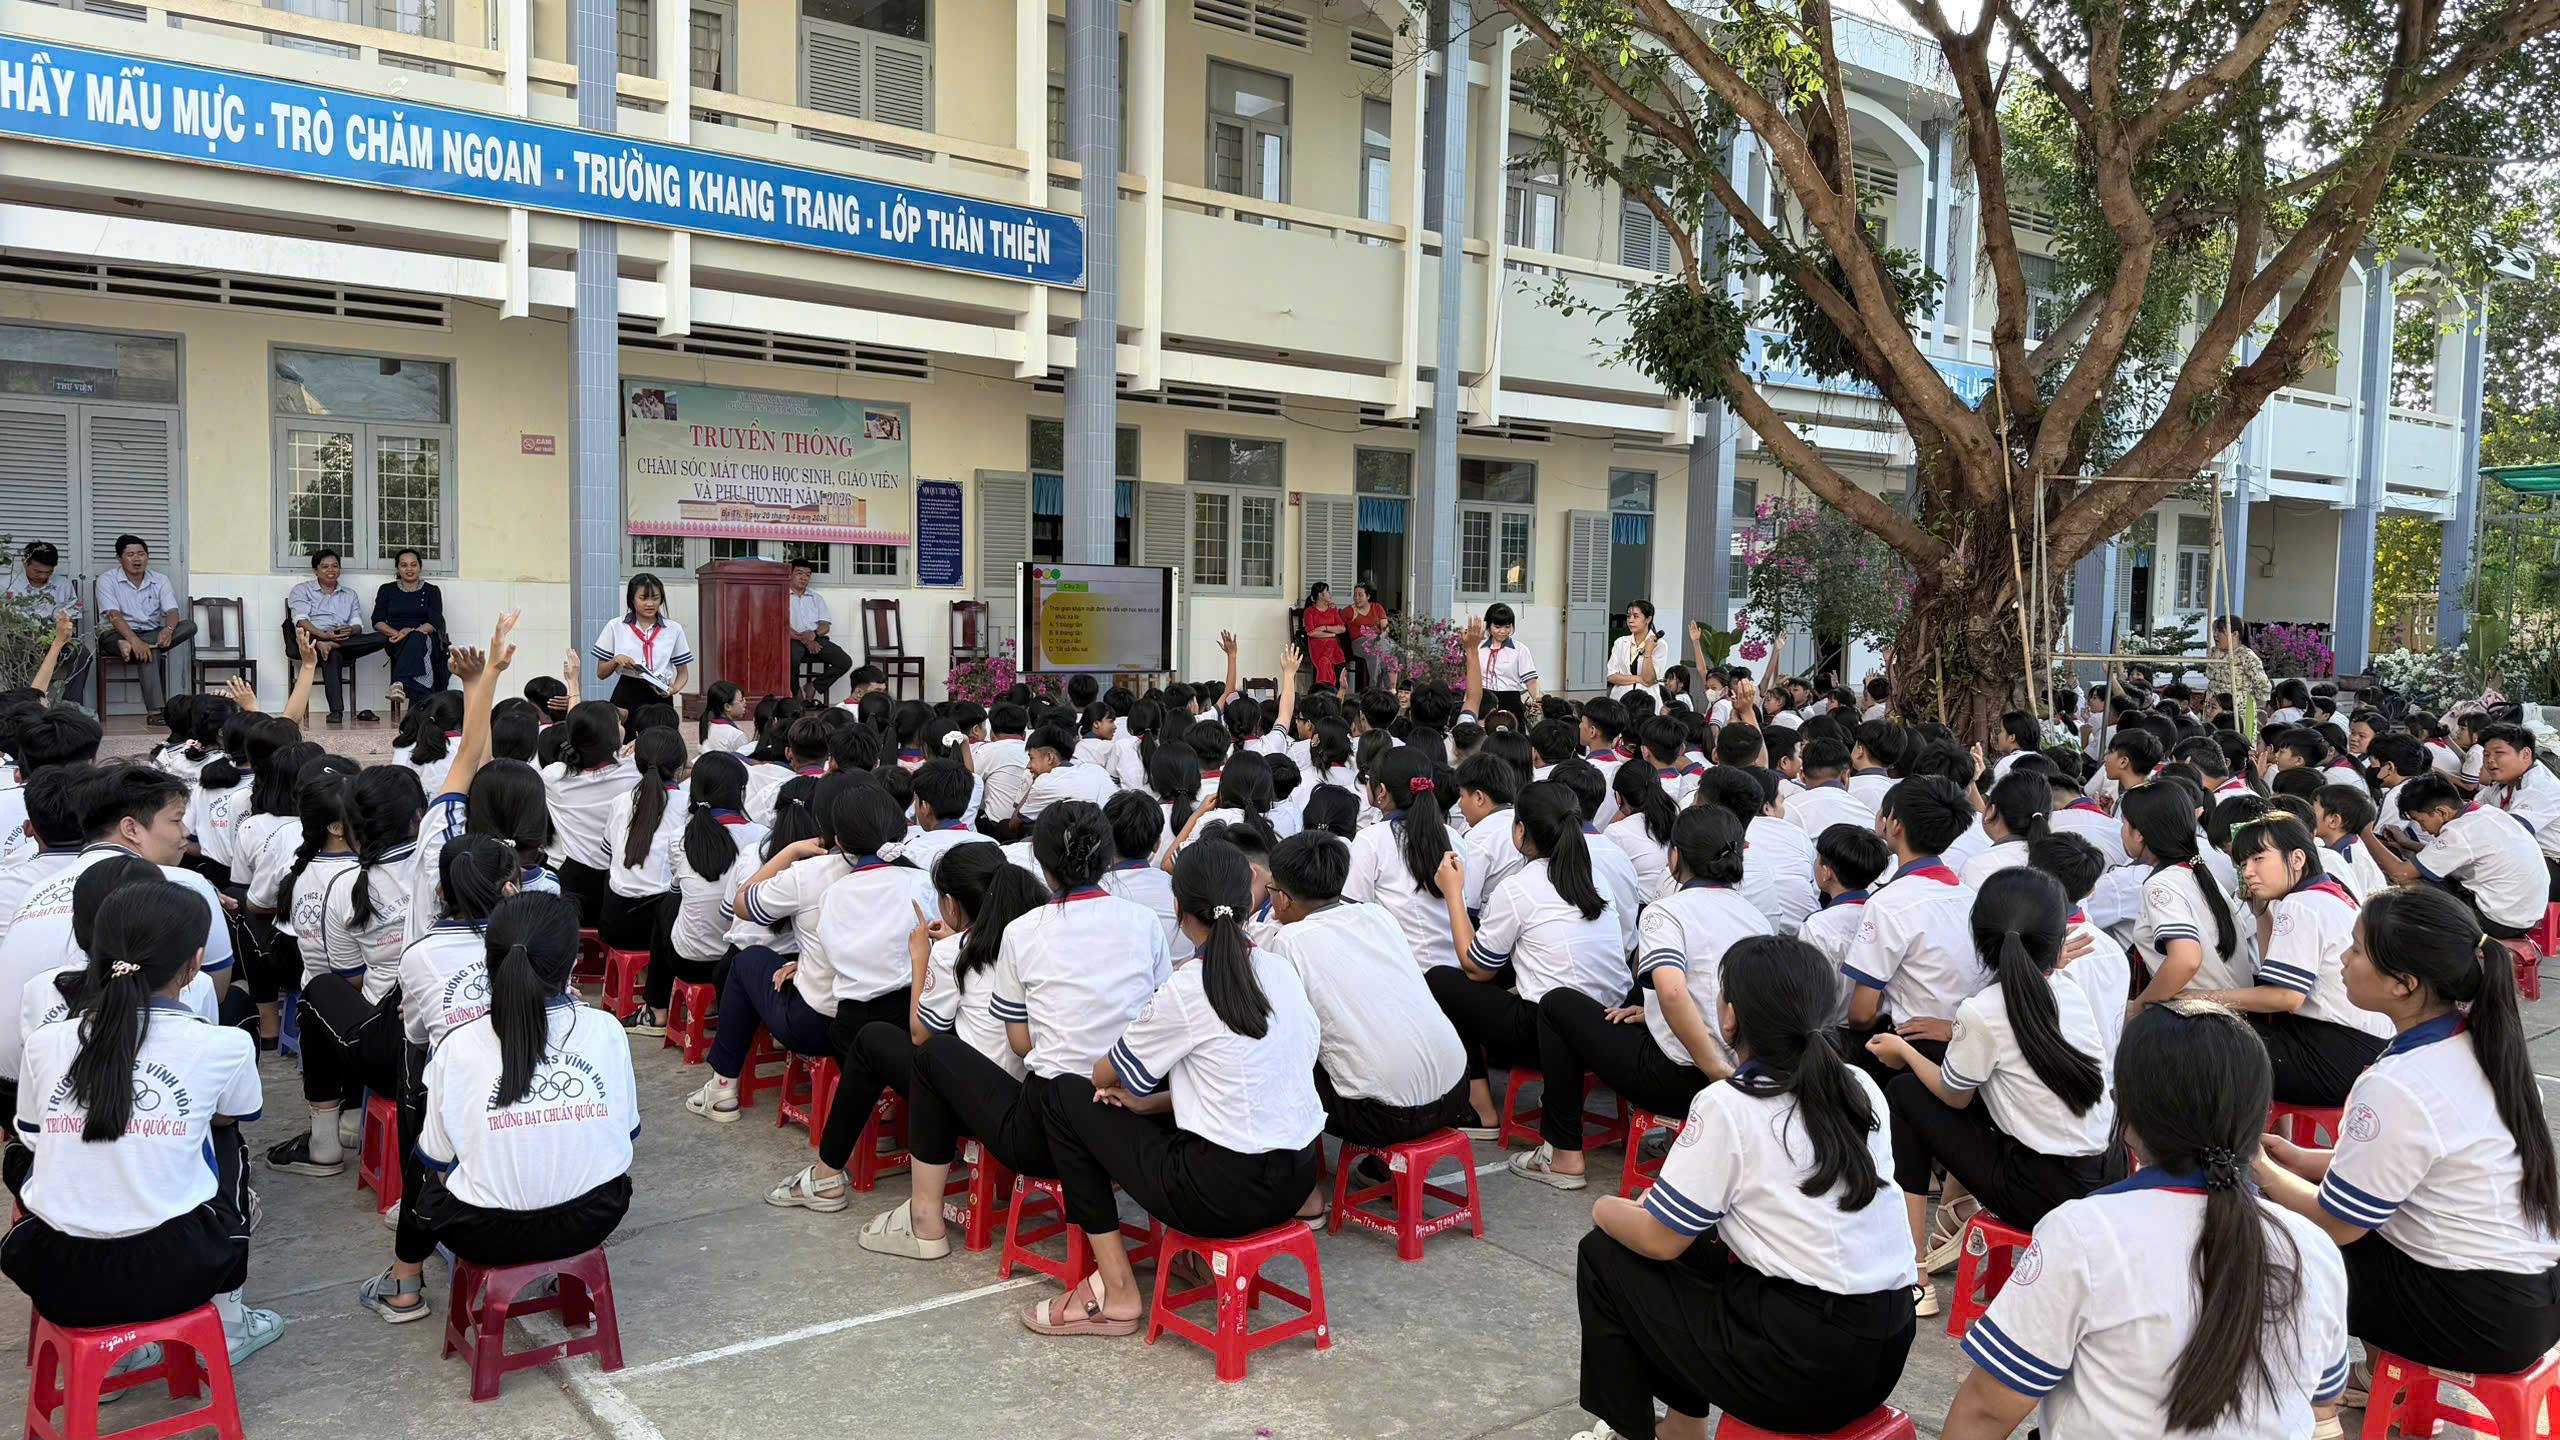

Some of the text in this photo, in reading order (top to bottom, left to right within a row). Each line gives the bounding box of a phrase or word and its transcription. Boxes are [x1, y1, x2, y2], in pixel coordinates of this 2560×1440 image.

[87, 66, 161, 131] MẪU
[174, 83, 246, 153] MỰC
[271, 97, 334, 156] TRÒ
[346, 110, 433, 171] CHĂM
[443, 131, 541, 187] NGOAN
[574, 147, 680, 208] TRƯỜNG
[689, 171, 774, 221] KHANG
[782, 186, 859, 236] TRANG
[880, 193, 921, 244] LỚP
[928, 206, 984, 254] THÂN
[990, 217, 1051, 273] THIỆN
[690, 419, 853, 457] TRUYỀN THÔNG
[680, 457, 707, 477] SÓC
[741, 464, 769, 481] CHO
[772, 465, 799, 485] HỌC
[801, 468, 835, 486] SINH,
[869, 471, 899, 489] VIÊN
[694, 480, 712, 499] VÀ
[827, 492, 852, 506] 2026
[443, 961, 486, 1011] TRƯỜNG TH
[146, 1061, 180, 1089] VĨNH
[564, 1053, 593, 1074] VĨNH
[142, 1113, 169, 1136] QUỐC
[172, 1120, 187, 1136] GIA
[487, 1097, 609, 1131] TRƯỜNG ĐẠT CHUẨN QUỐC GIA
